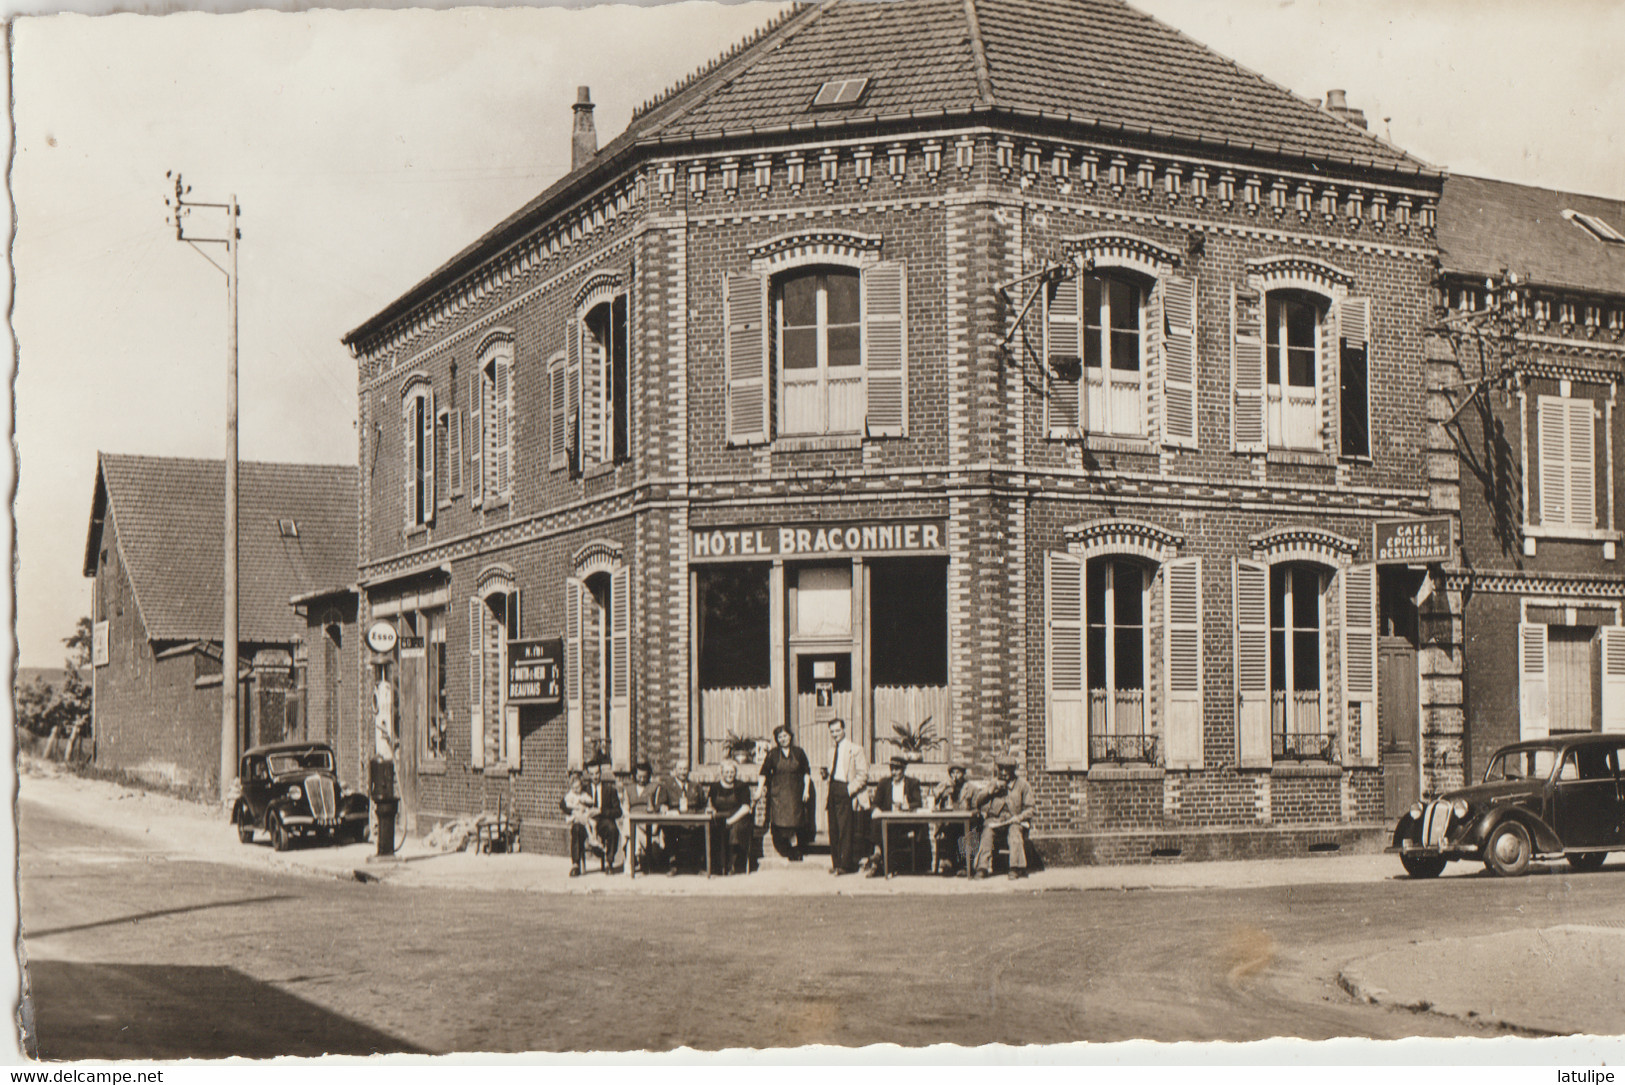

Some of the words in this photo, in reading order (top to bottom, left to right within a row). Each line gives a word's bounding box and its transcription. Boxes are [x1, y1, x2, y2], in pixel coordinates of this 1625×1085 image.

[1397, 523, 1427, 536] CAFÉ
[694, 531, 771, 556] HÔTEL
[779, 525, 940, 555] BRACONNIER
[1380, 545, 1447, 559] RESTAURANT
[510, 682, 541, 697] BEAUVAIS
